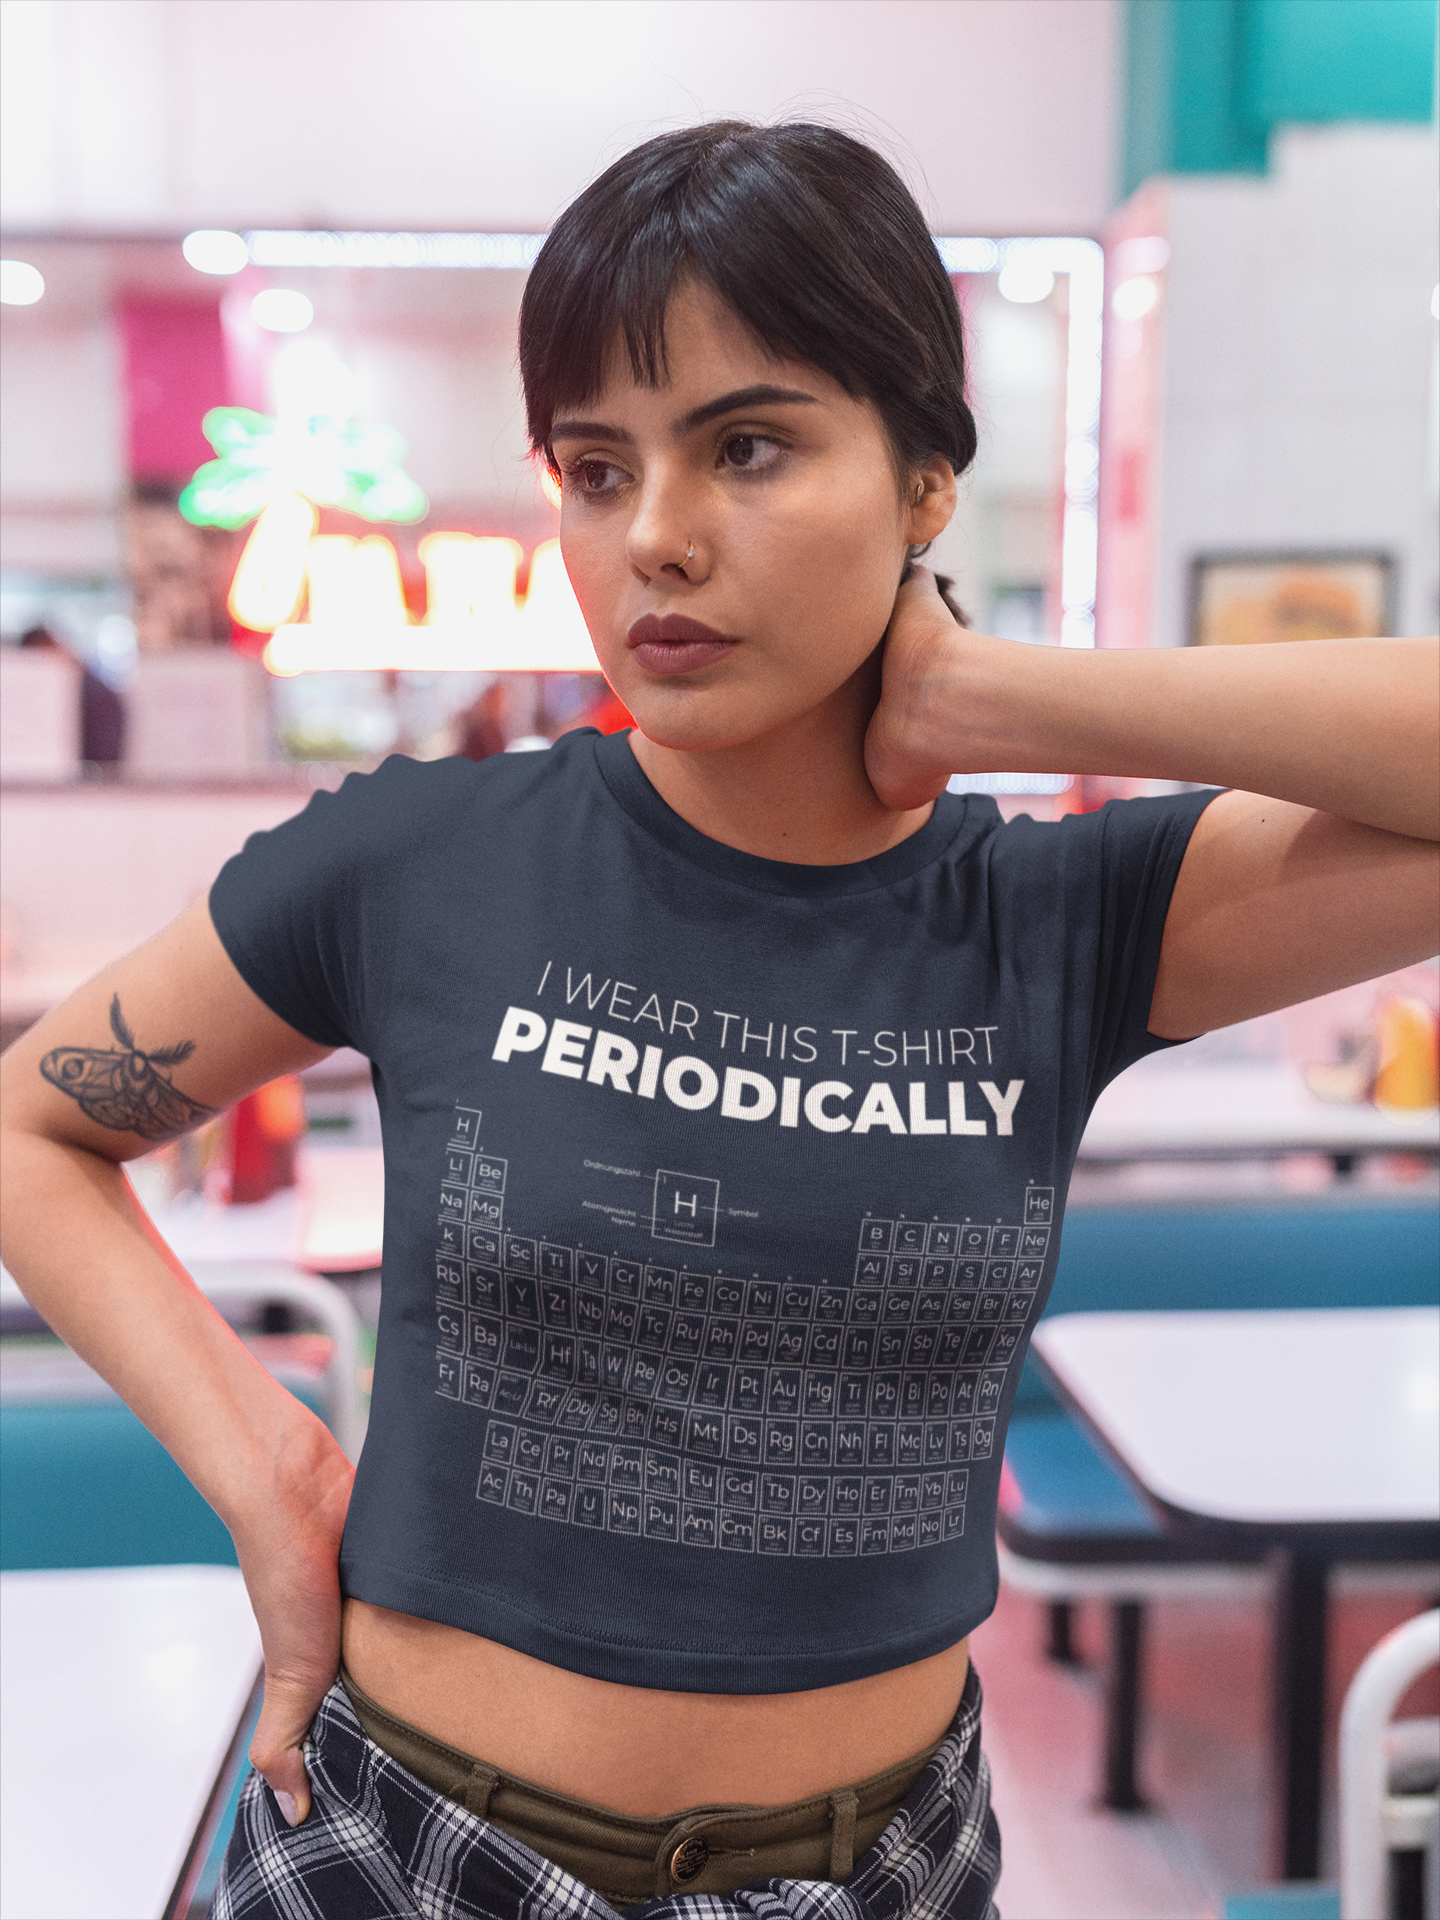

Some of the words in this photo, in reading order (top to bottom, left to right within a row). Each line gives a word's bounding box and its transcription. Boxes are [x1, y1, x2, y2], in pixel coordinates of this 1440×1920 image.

[537, 961, 552, 996] I
[567, 966, 699, 1041] WEAR
[713, 1010, 818, 1063] THIS
[831, 1026, 998, 1067] T-SHIRT
[492, 1006, 1025, 1136] PERIODICALLY
[457, 1118, 470, 1133] H
[450, 1158, 462, 1171] Li
[479, 1164, 501, 1179] Be
[584, 1159, 641, 1177] Ordnungszahl
[440, 1193, 462, 1208] Na
[473, 1201, 499, 1218] Mg
[675, 1191, 696, 1217] H
[728, 1207, 759, 1218] Symbol
[1029, 1197, 1049, 1210] He
[612, 1216, 636, 1227] Name
[871, 1228, 883, 1239] B
[905, 1230, 916, 1242] C
[938, 1233, 949, 1243] N
[969, 1234, 981, 1244] O
[1001, 1234, 1011, 1244] F
[1025, 1235, 1044, 1246] Ne
[473, 1236, 495, 1251] Ca
[510, 1245, 530, 1259] Sc
[549, 1253, 563, 1267] Ti
[586, 1261, 598, 1274] V
[616, 1270, 634, 1283] Cr
[648, 1276, 672, 1292] Mn
[684, 1283, 704, 1296] Fe
[717, 1287, 739, 1301] Co
[756, 1291, 771, 1304] Ni
[786, 1292, 808, 1306] Cu
[821, 1295, 842, 1308] Zn
[855, 1299, 876, 1311] Ga
[889, 1299, 909, 1310] Ge
[922, 1299, 940, 1310] As
[953, 1299, 970, 1310] Se
[984, 1300, 999, 1309] Br
[1012, 1300, 1028, 1309] Kr
[899, 1264, 912, 1276] Si
[933, 1266, 944, 1276] P
[965, 1267, 974, 1278] S
[1020, 1268, 1036, 1278] Ar
[437, 1265, 460, 1283] Rb
[476, 1276, 494, 1293] Sr
[516, 1287, 527, 1301] Y
[550, 1294, 566, 1311] Zr
[579, 1301, 602, 1318] Nb
[610, 1309, 633, 1326] Mo
[646, 1317, 663, 1333] Tc
[676, 1323, 699, 1340] Ru
[711, 1327, 733, 1343] Rh
[745, 1331, 768, 1347] Pd
[779, 1334, 802, 1351] Ag
[814, 1335, 837, 1350] Cd
[852, 1337, 867, 1351] In
[882, 1337, 900, 1351] Sn
[913, 1335, 932, 1348] Sb
[945, 1333, 960, 1347] Te
[997, 1334, 1014, 1347] Xe
[438, 1316, 459, 1335] Cs
[475, 1326, 496, 1346] Ba
[551, 1345, 570, 1364] Hf
[608, 1357, 621, 1372] W
[635, 1362, 654, 1379] Re
[666, 1369, 688, 1386] Os
[707, 1373, 719, 1389] Ir
[740, 1377, 758, 1394] Pt
[773, 1380, 796, 1397] Au
[808, 1382, 832, 1402] Hg
[875, 1383, 895, 1400] Pb
[909, 1383, 921, 1399] Bi
[932, 1383, 948, 1399] Po
[958, 1383, 972, 1398] At
[981, 1381, 998, 1396] Rn
[439, 1364, 454, 1382] Fr
[470, 1374, 489, 1392] Ra
[537, 1392, 558, 1408] Rf
[567, 1399, 590, 1415] Db
[600, 1403, 617, 1422] Sg
[627, 1408, 643, 1423] Bh
[655, 1415, 677, 1432] Hs
[694, 1423, 718, 1441] Mt
[734, 1426, 757, 1445] Ds
[770, 1432, 792, 1450] Rg
[805, 1433, 827, 1448] Cn
[840, 1433, 861, 1449] Nh
[901, 1434, 920, 1448] Mc
[930, 1433, 943, 1448] Lv
[955, 1431, 966, 1446] Ts
[975, 1429, 990, 1449] Og
[492, 1432, 508, 1447] La
[521, 1440, 540, 1456] Ce
[554, 1446, 570, 1461] Pr
[583, 1451, 605, 1467] Nd
[614, 1455, 640, 1472] Pm
[648, 1461, 677, 1480] Sm
[690, 1469, 712, 1487] Eu
[726, 1478, 753, 1494] Gd
[768, 1483, 789, 1498] Tb
[803, 1486, 825, 1502] Dy
[837, 1487, 858, 1499] Ho
[872, 1487, 886, 1499] Er
[898, 1486, 917, 1498] Tm
[926, 1483, 941, 1495] Yb
[951, 1480, 963, 1492] Lu
[483, 1473, 502, 1489] Ac
[515, 1481, 532, 1497] Th
[546, 1489, 566, 1505] Pa
[583, 1496, 595, 1510] U
[613, 1501, 637, 1520] Np
[650, 1507, 673, 1524] Pu
[684, 1515, 713, 1531] Am
[722, 1520, 751, 1536] Cm
[764, 1525, 787, 1541] Bk
[802, 1528, 820, 1542] Cf
[836, 1529, 853, 1542] Es
[864, 1528, 886, 1540] Fm
[894, 1524, 914, 1537] Md
[922, 1521, 938, 1533] No
[950, 1515, 959, 1527] Lr
